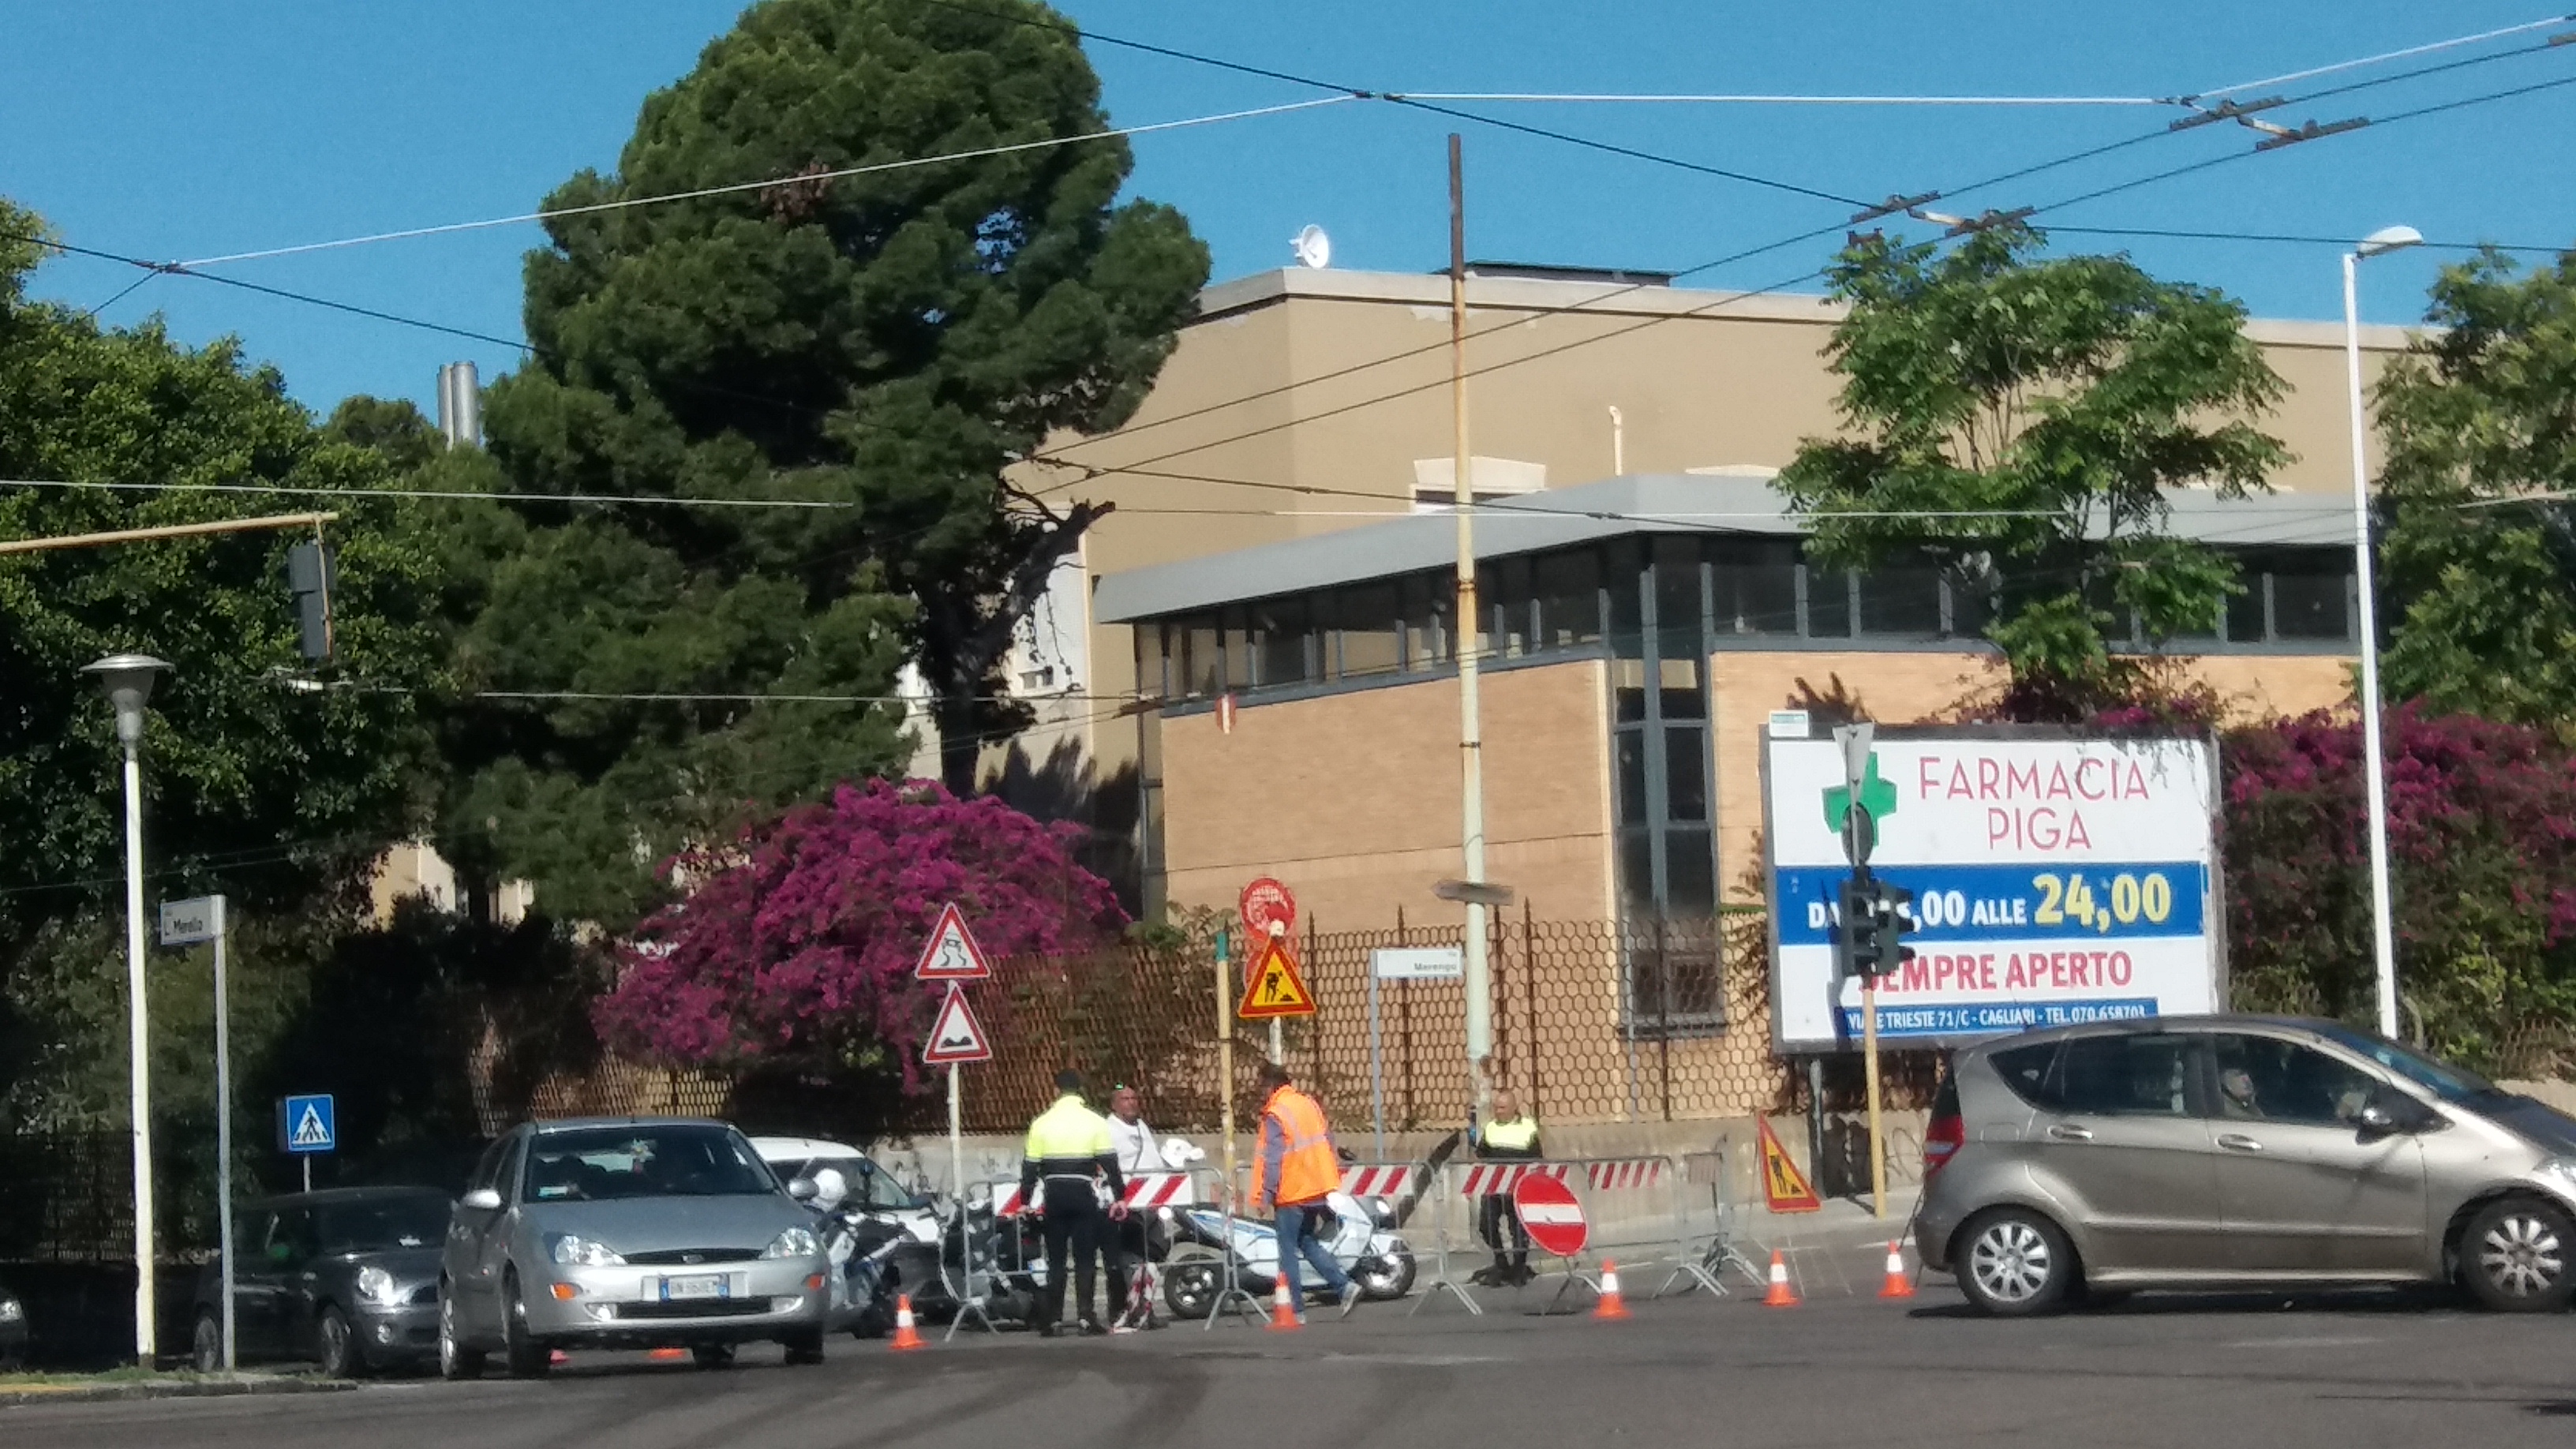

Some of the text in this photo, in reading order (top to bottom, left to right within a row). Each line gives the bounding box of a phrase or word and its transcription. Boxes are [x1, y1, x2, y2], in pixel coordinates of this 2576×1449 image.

[1919, 756, 2150, 800] FARMACIA
[1987, 807, 2092, 851] PIGA
[1971, 898, 2027, 925] ALLE
[2032, 873, 2170, 933] 24,00
[2005, 950, 2132, 988] APERTO
[1885, 1010, 1936, 1029] TRIESTE
[1938, 1009, 1970, 1030] 71/C
[1979, 1007, 2036, 1026] CAGLIARI
